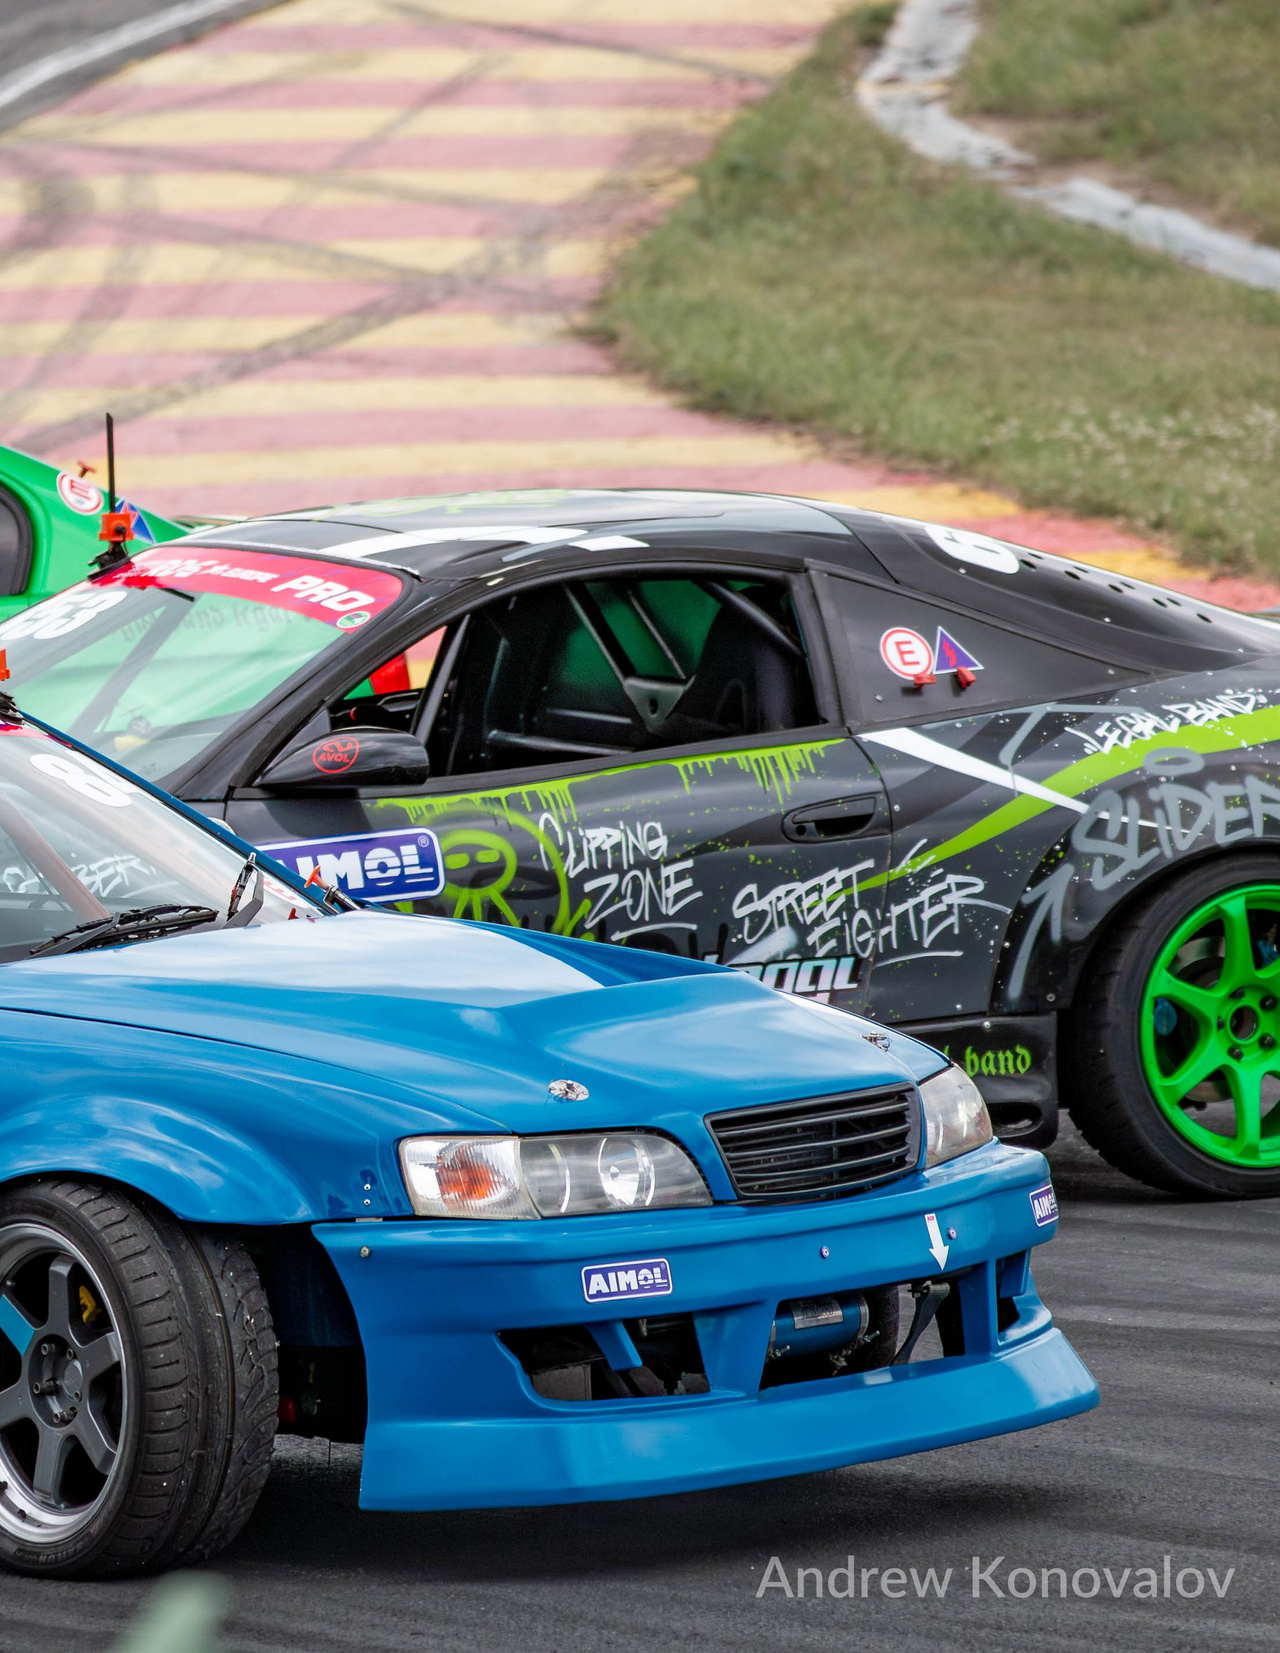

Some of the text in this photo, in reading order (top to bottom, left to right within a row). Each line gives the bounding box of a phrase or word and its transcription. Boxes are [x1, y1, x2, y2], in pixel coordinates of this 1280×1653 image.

[271, 575, 375, 611] PRO
[894, 640, 920, 667] E
[317, 752, 351, 763] AVOL
[277, 841, 435, 890] IMOL
[584, 859, 703, 930] ZONE
[964, 1045, 1032, 1079] band
[588, 1262, 669, 1295] AIMOL
